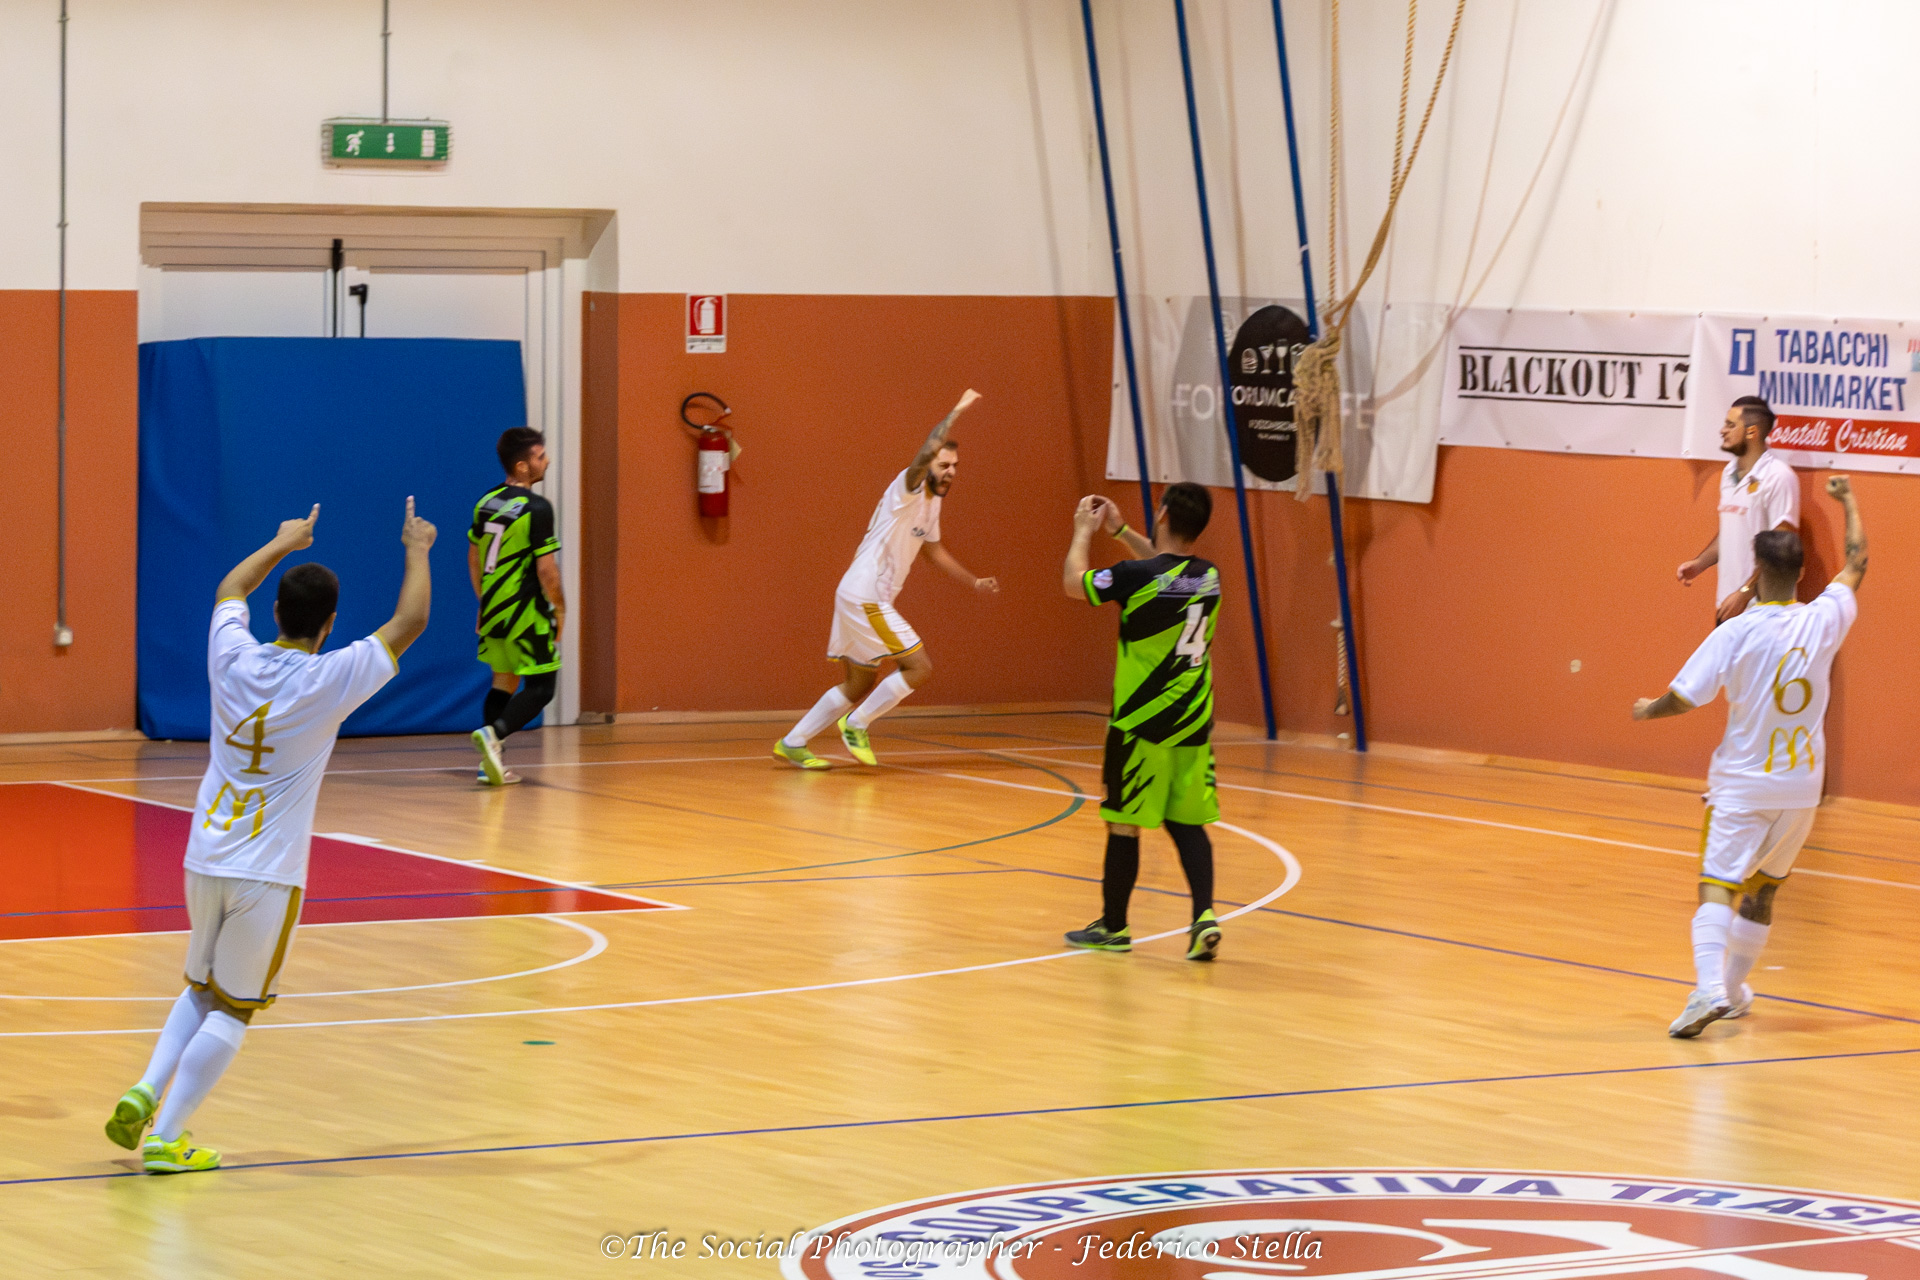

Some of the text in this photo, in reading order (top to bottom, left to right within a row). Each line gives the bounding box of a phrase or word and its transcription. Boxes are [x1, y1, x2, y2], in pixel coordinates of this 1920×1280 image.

[1776, 329, 1889, 368] TABACCHI
[1459, 354, 1690, 401] BLACKOUT 17
[1759, 371, 1907, 412] MINIMARKET
[1834, 418, 1909, 453] Cristian
[483, 522, 506, 574] 7
[1175, 602, 1210, 668] 4
[1773, 647, 1814, 716] 6
[225, 699, 276, 775] 4
